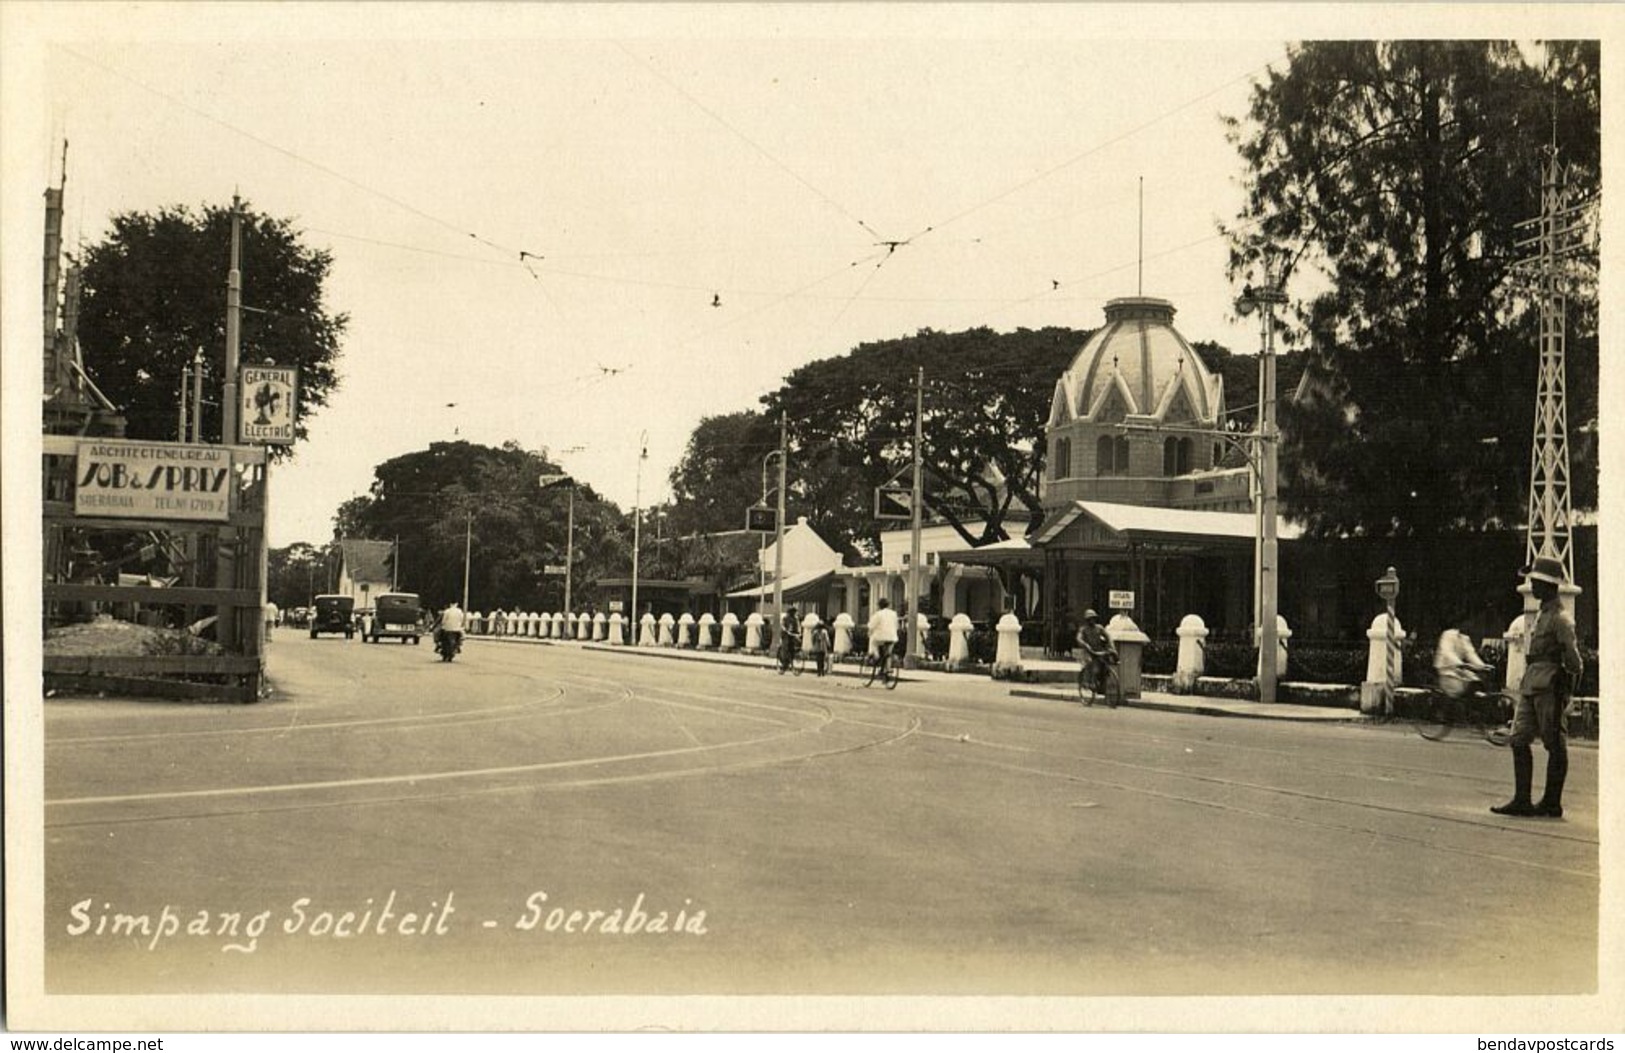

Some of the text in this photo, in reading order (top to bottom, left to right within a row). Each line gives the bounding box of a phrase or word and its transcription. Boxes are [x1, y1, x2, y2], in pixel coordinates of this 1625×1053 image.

[245, 370, 292, 387] GENERAL
[245, 422, 291, 438] ELECTRIC
[90, 446, 221, 461] ARCHITECTENBUREAU
[79, 462, 129, 489] JOB
[130, 472, 142, 489] &
